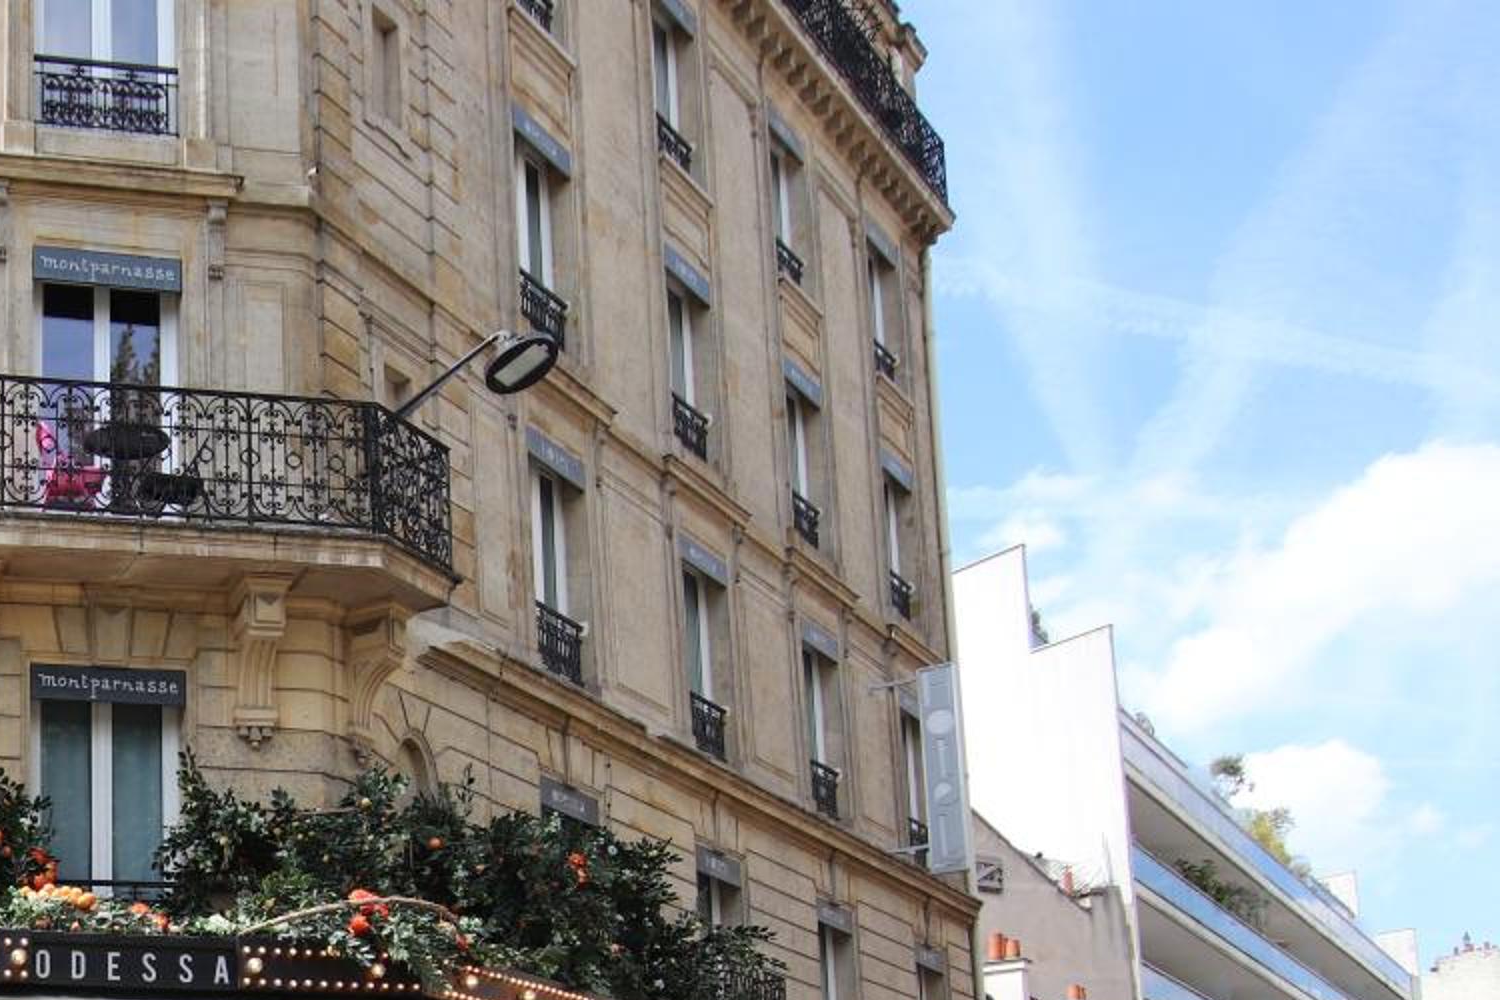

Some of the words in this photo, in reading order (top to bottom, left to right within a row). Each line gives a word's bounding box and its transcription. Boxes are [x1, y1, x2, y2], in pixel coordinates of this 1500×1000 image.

[40, 255, 175, 282] montparnasse
[38, 673, 178, 700] montparnasse
[35, 949, 230, 985] ODESSA
